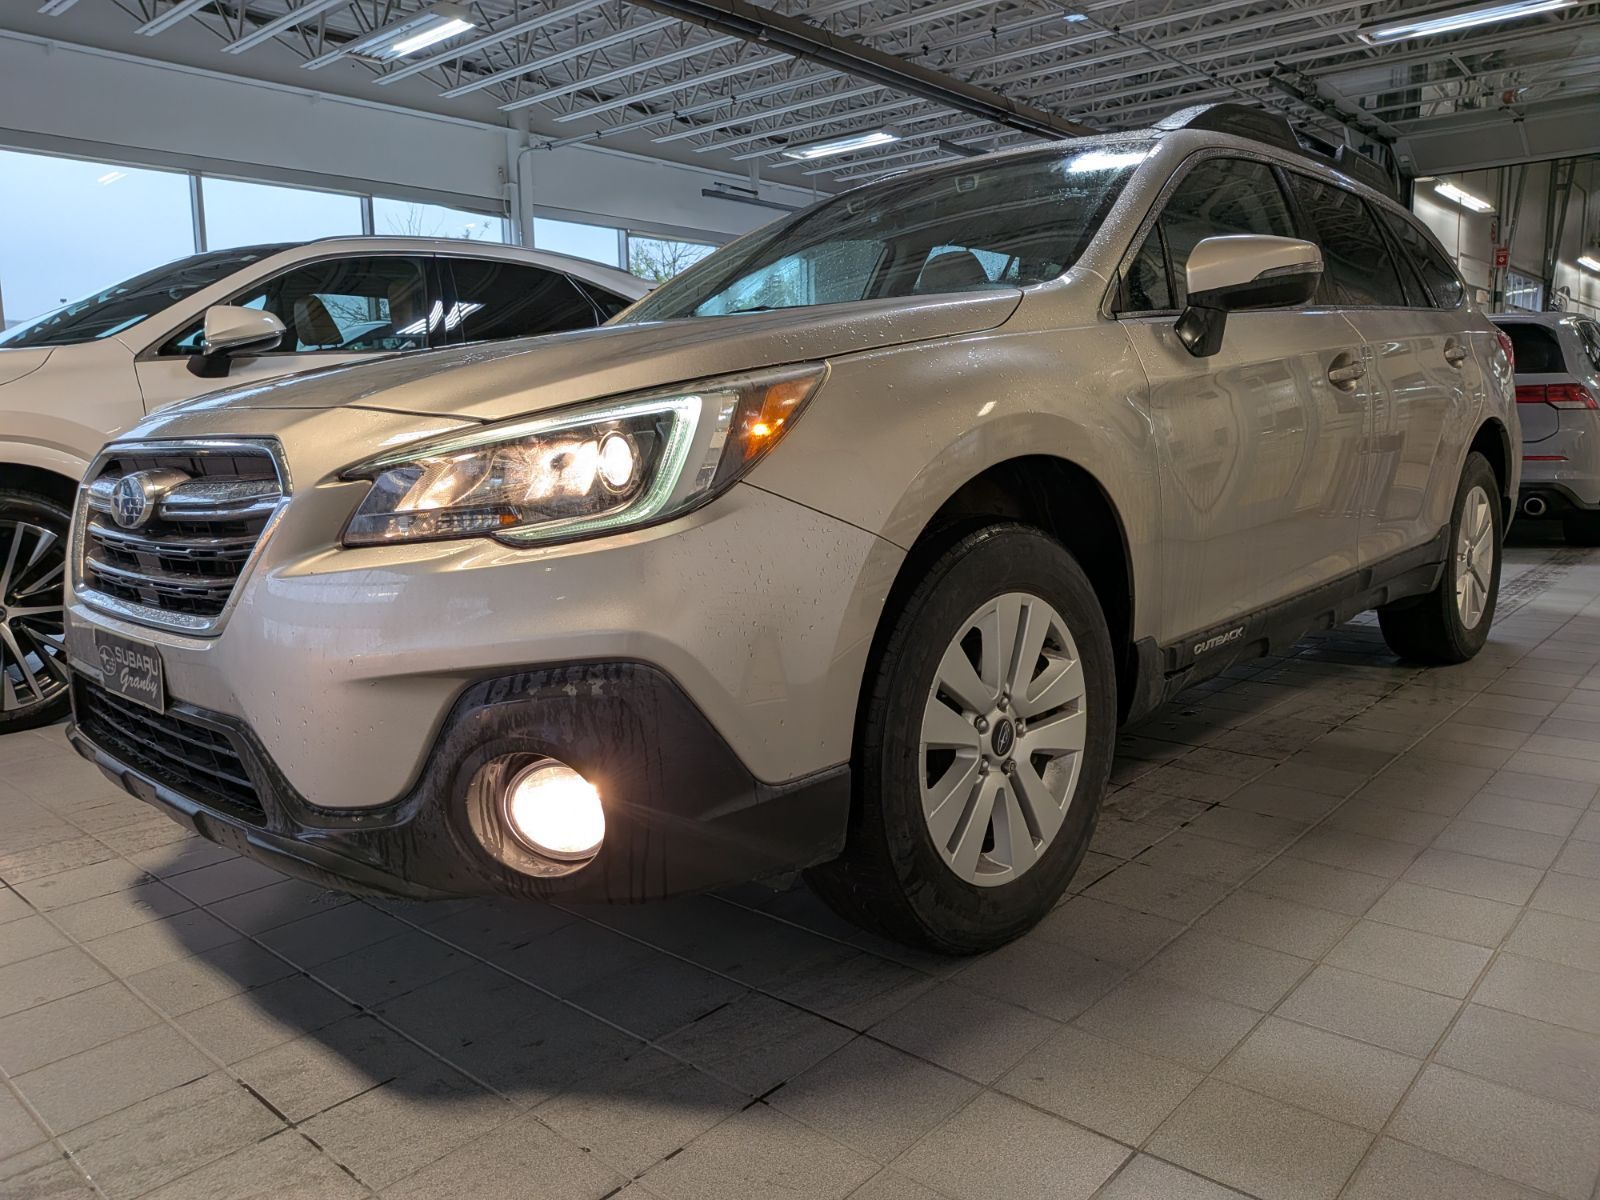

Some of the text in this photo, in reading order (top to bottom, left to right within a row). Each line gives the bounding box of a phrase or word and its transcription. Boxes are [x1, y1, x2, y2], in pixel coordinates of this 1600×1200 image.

[1193, 627, 1244, 655] OUTBACK
[114, 646, 158, 676] SUBARU
[120, 667, 157, 698] Granby
